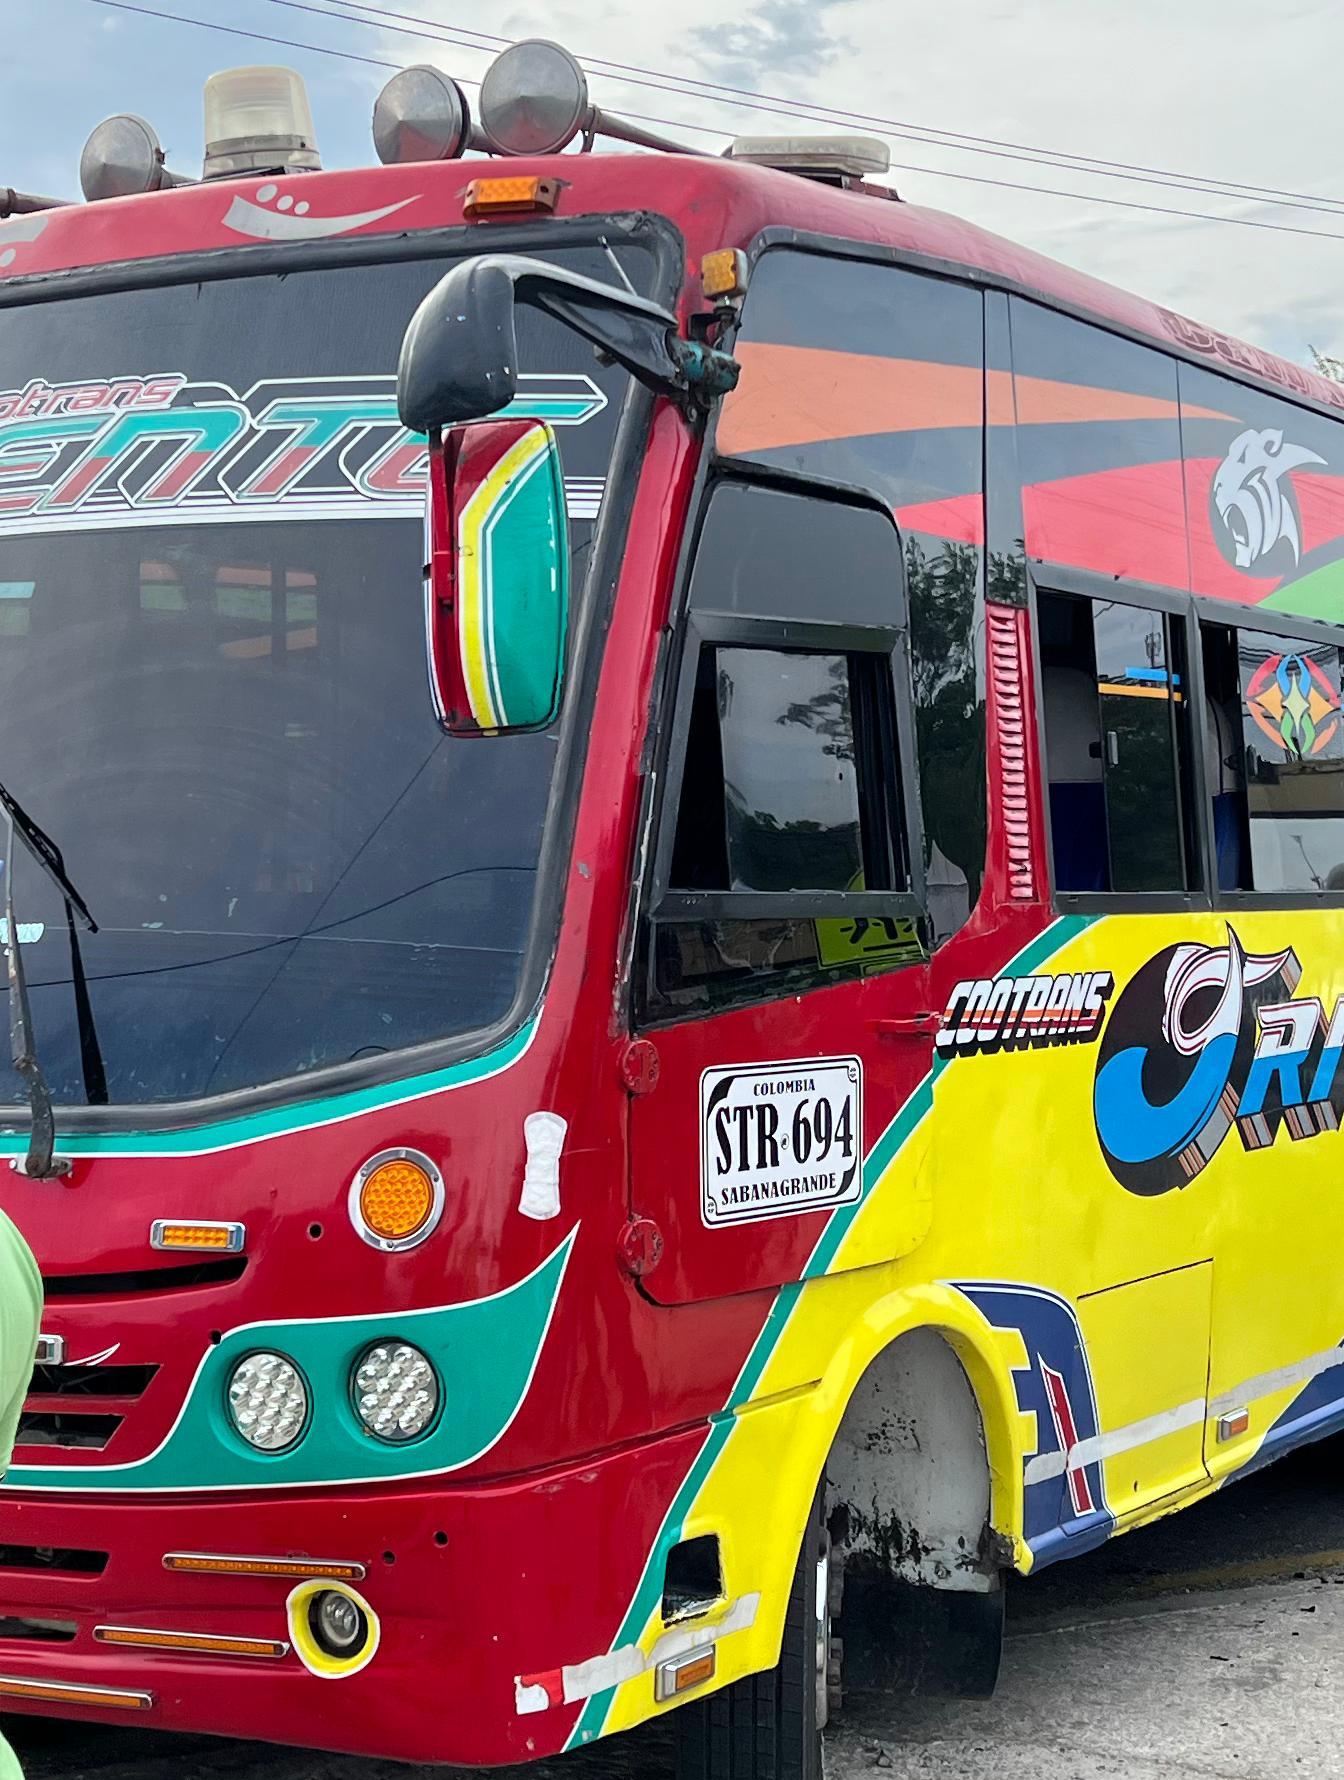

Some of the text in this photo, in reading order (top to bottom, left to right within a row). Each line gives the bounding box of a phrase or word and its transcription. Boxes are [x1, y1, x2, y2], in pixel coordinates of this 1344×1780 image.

[933, 970, 1115, 1058] COOTRANS
[753, 1078, 816, 1097] COLOMBIA
[715, 1094, 854, 1175] STR 694
[721, 1172, 837, 1206] SABANAGRANDE
